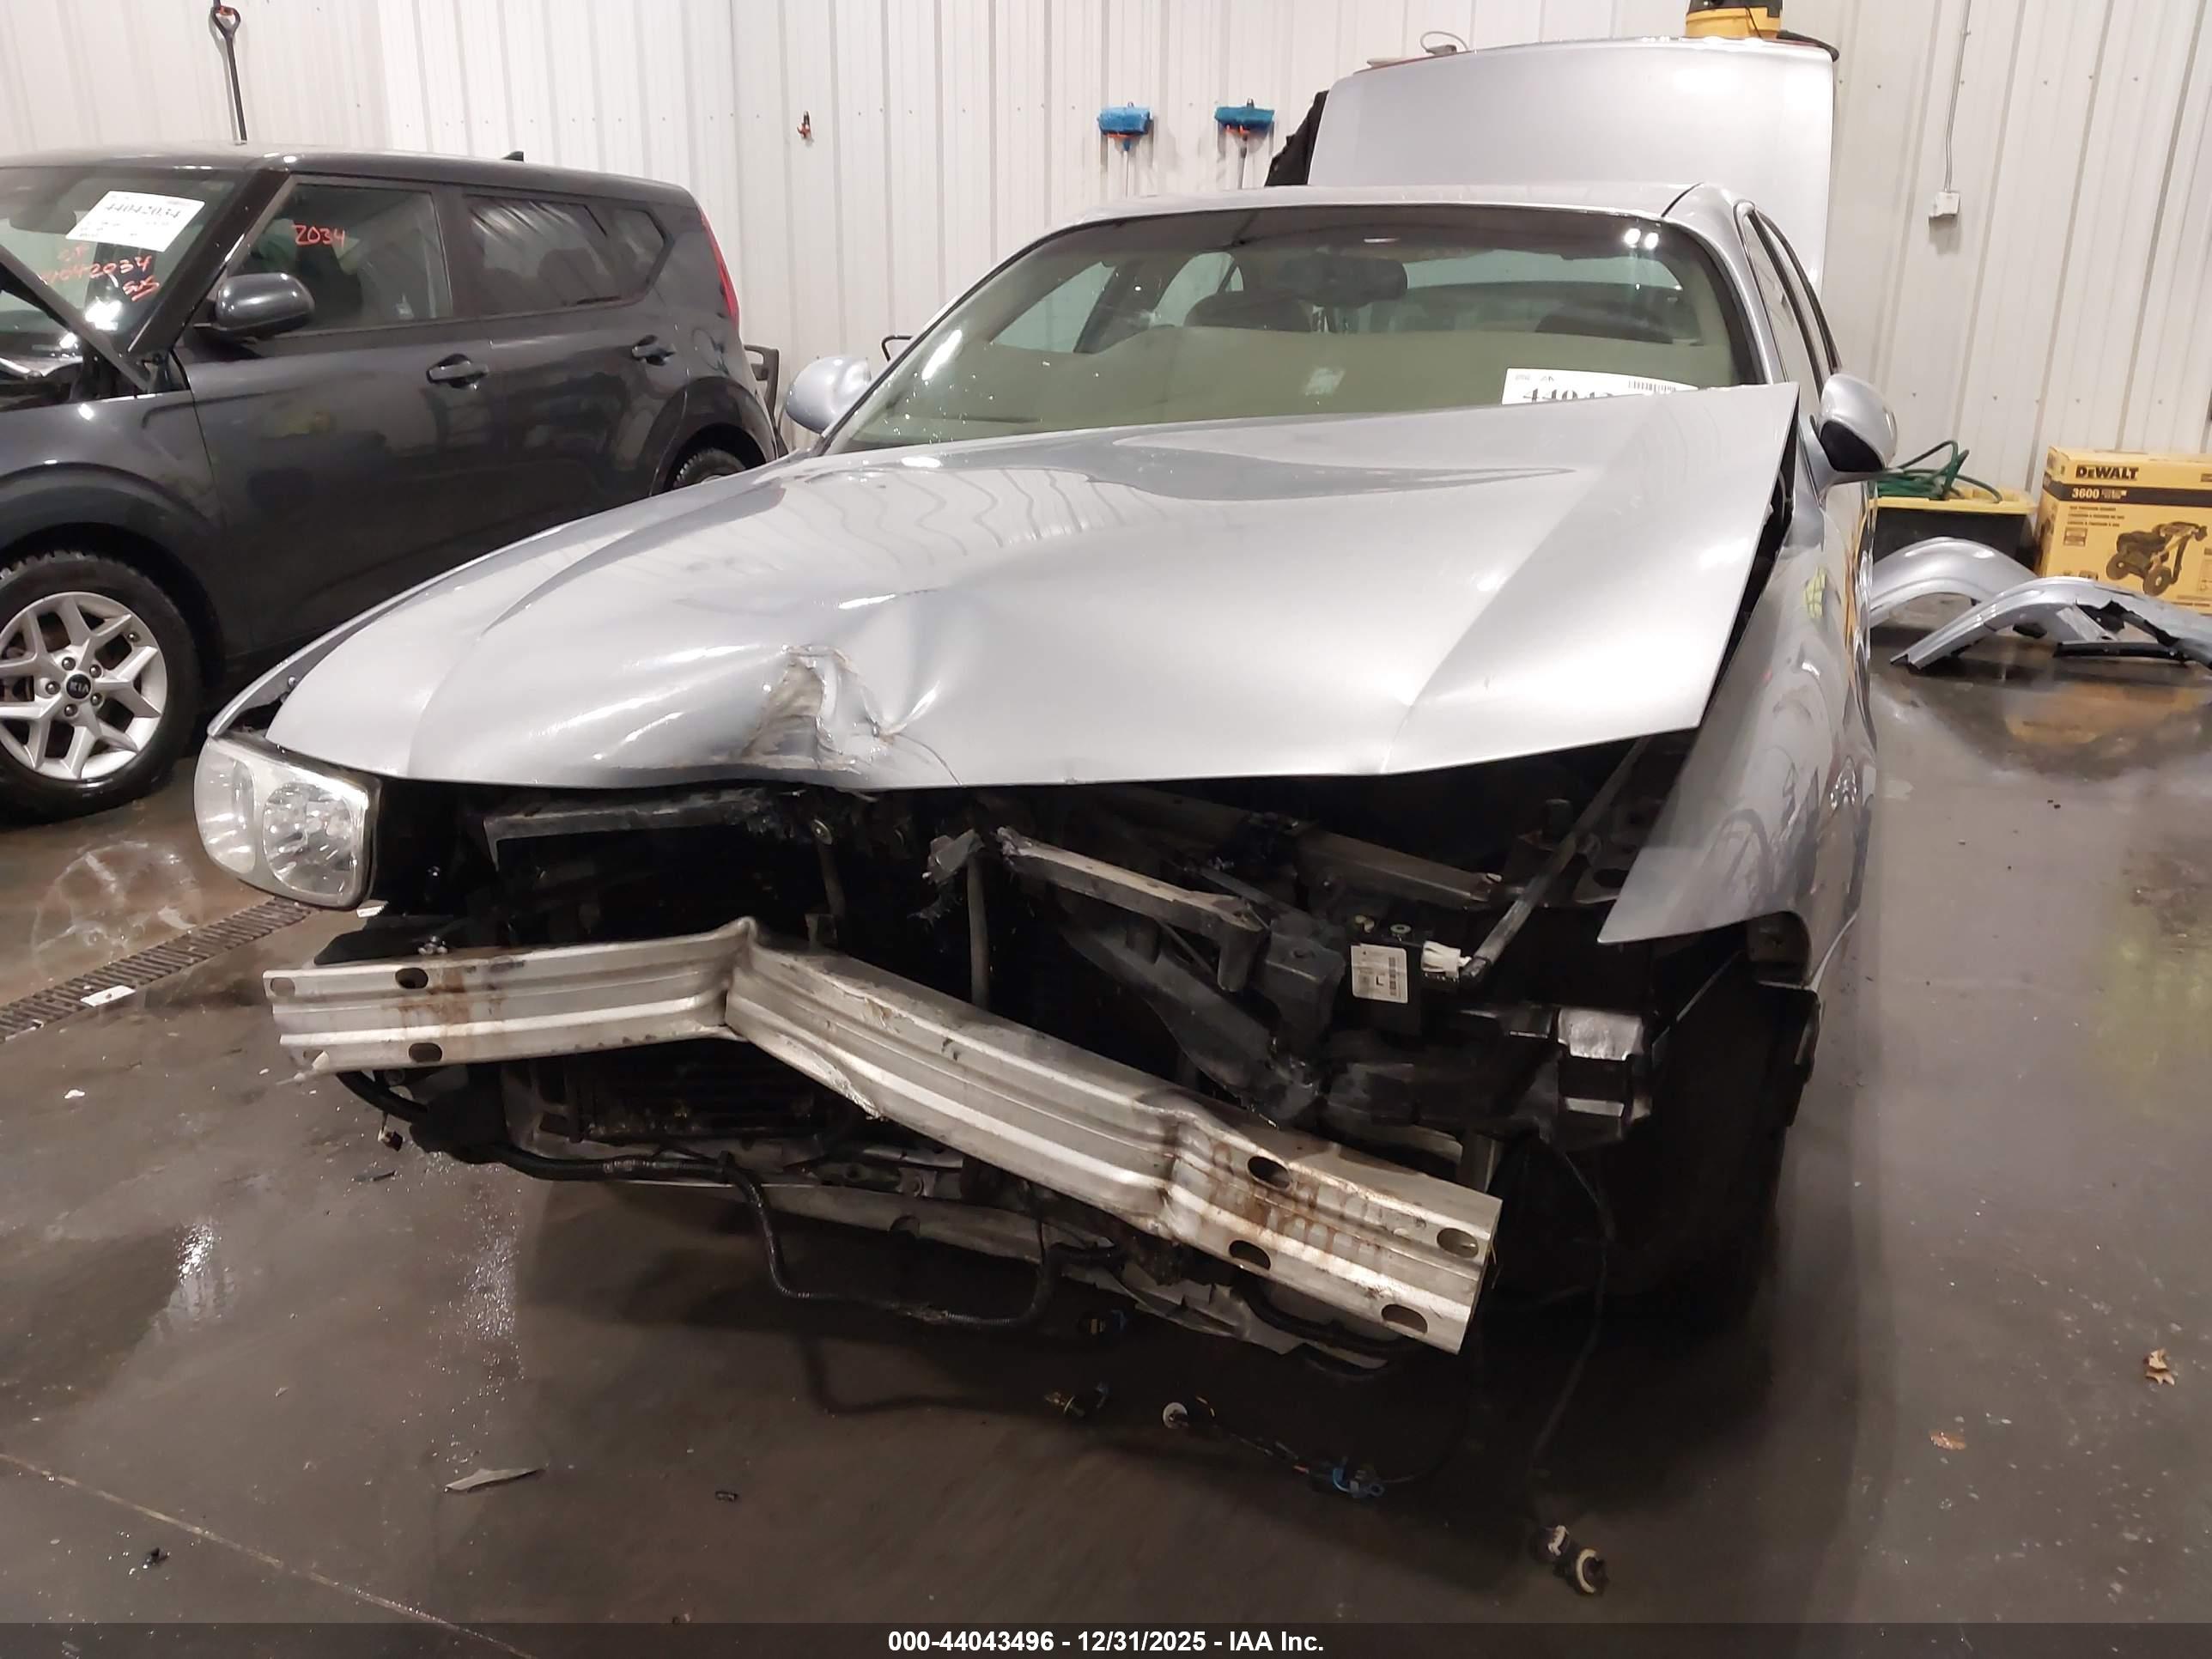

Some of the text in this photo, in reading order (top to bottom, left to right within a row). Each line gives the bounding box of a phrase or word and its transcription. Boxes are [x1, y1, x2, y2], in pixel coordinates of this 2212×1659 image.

[291, 224, 345, 247] 2034
[2072, 488, 2100, 500] 3600
[70, 681, 88, 693] KIA
